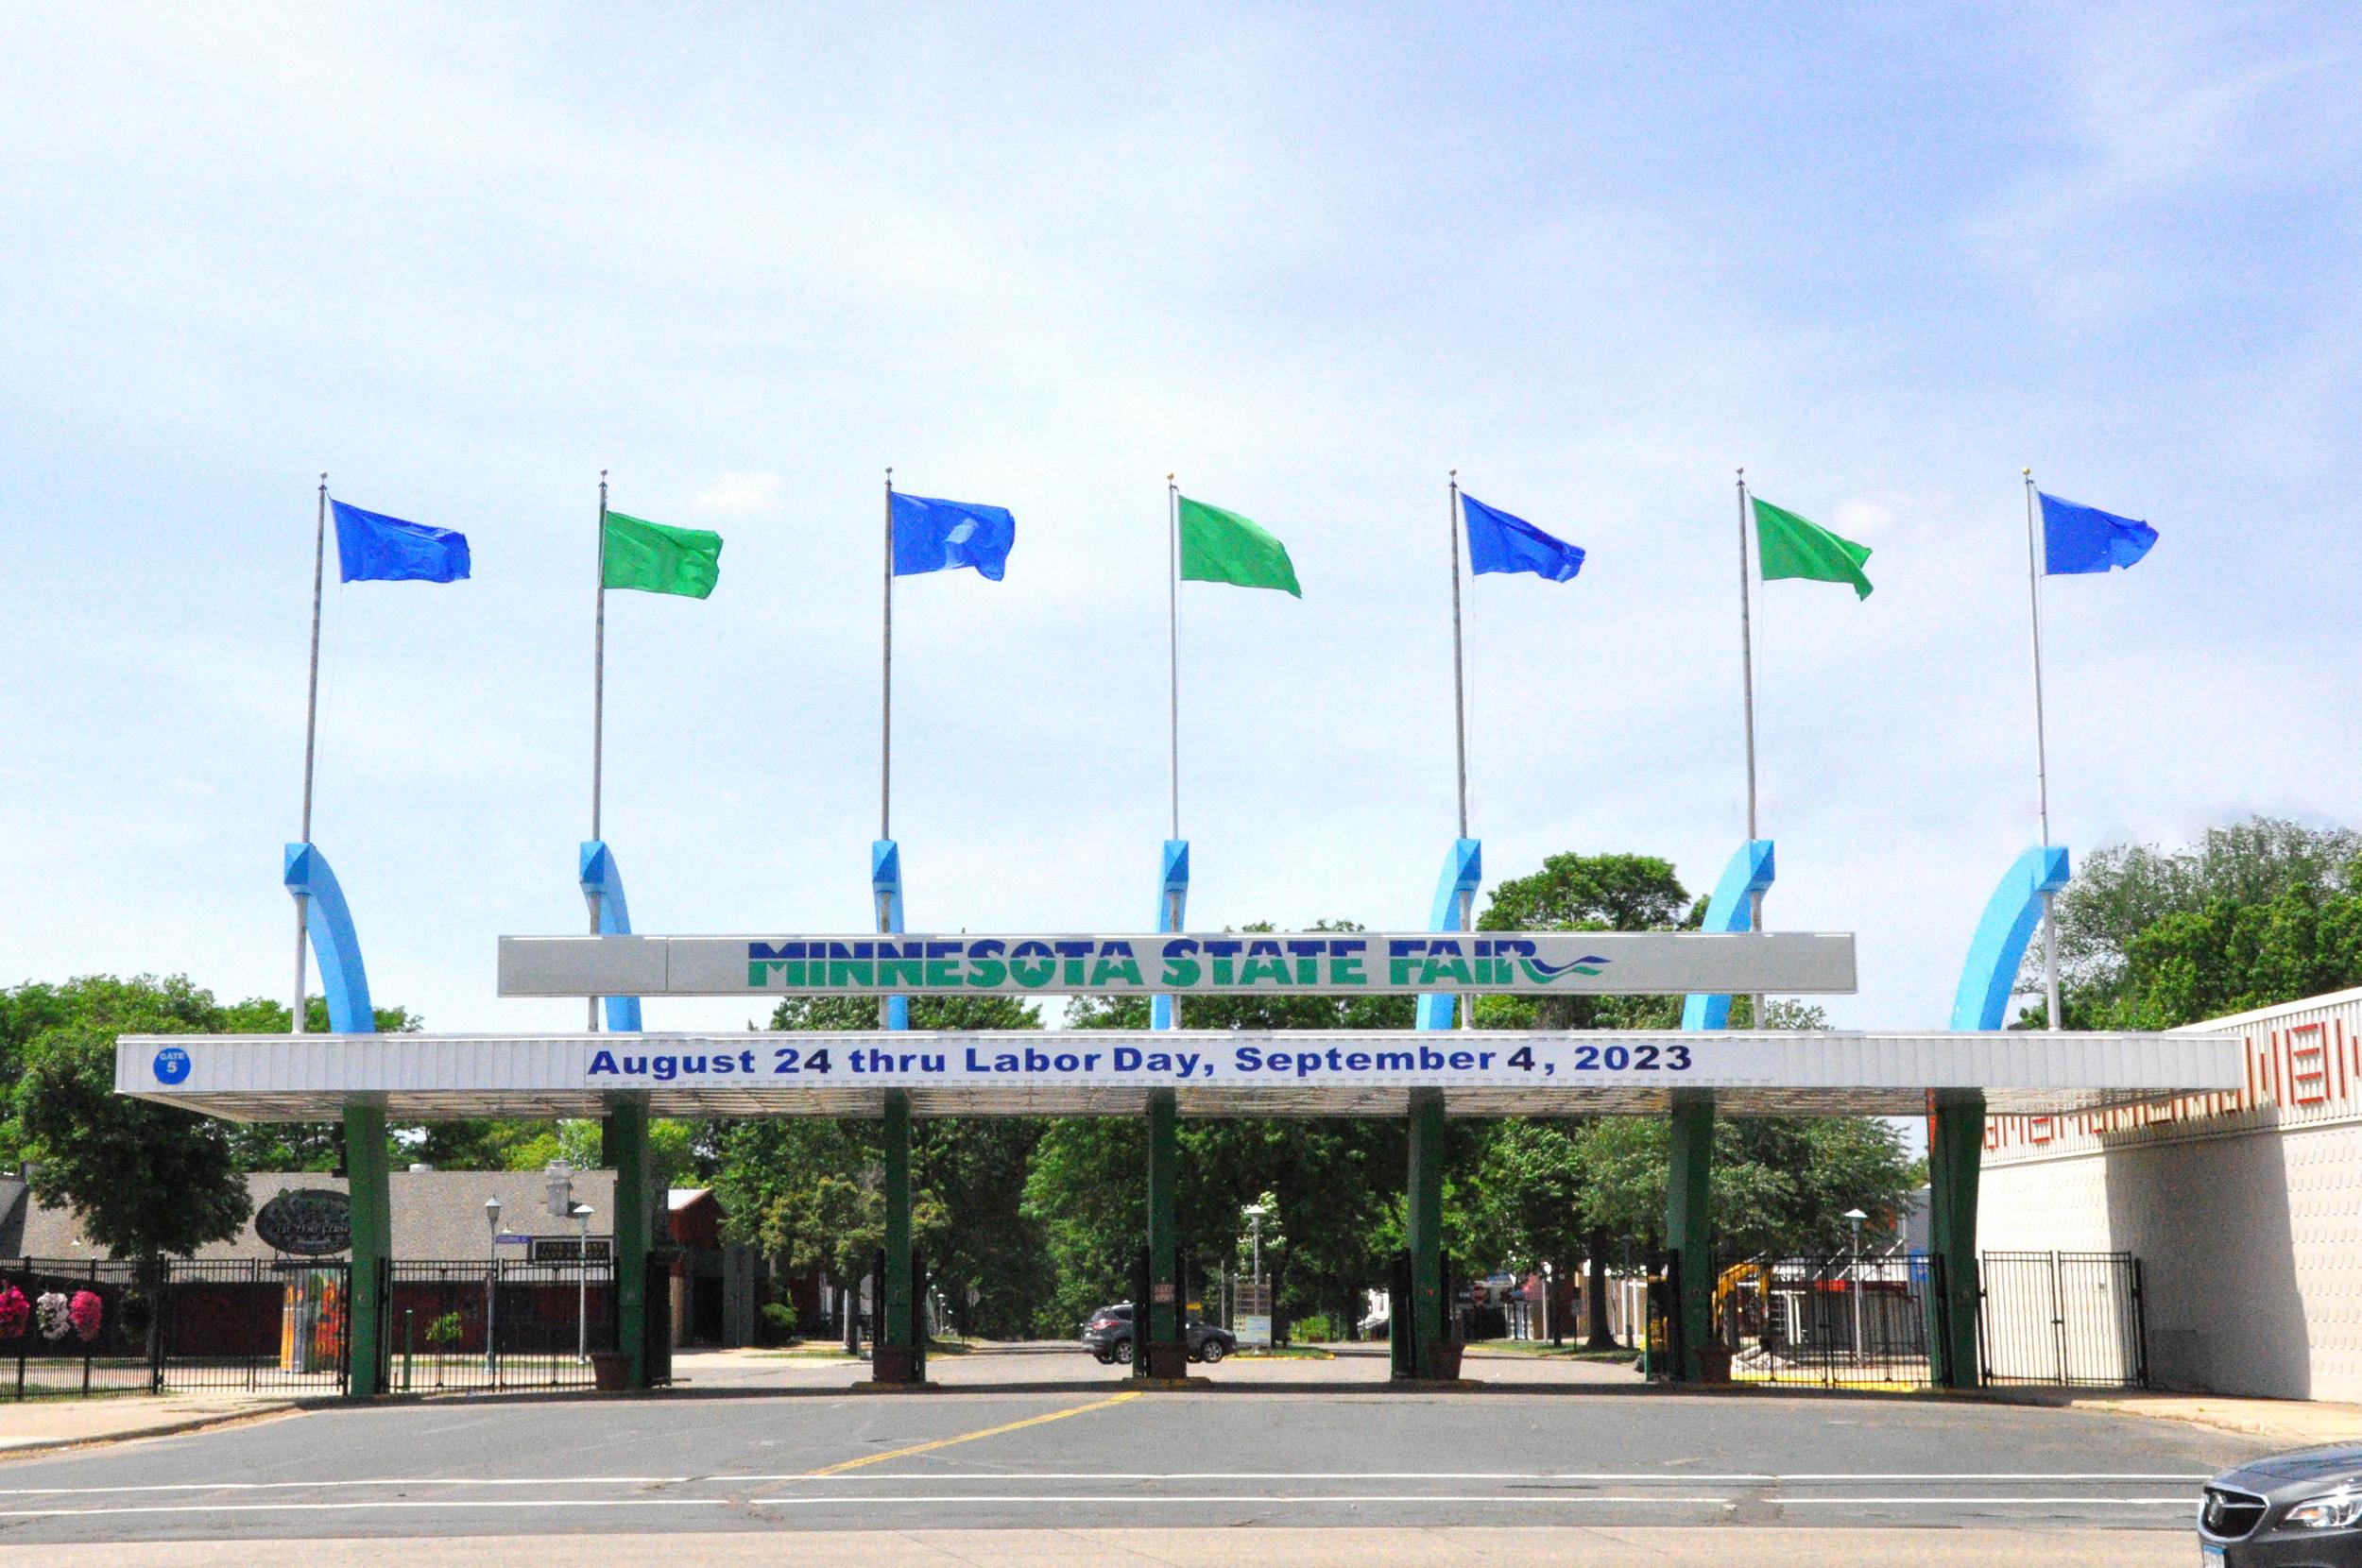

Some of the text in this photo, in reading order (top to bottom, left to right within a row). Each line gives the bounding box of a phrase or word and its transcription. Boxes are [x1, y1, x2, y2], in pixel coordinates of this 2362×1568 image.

[747, 938, 1612, 989] MINNESOTA STATE FAIR
[160, 1051, 186, 1061] GATE
[166, 1060, 178, 1074] 5
[587, 1049, 756, 1081] August
[773, 1048, 832, 1074] 24
[848, 1048, 945, 1073] thru
[965, 1047, 1103, 1073] Labor
[1113, 1047, 1215, 1079] Day,
[1234, 1046, 1497, 1078] September
[1573, 1045, 1692, 1071] 2023
